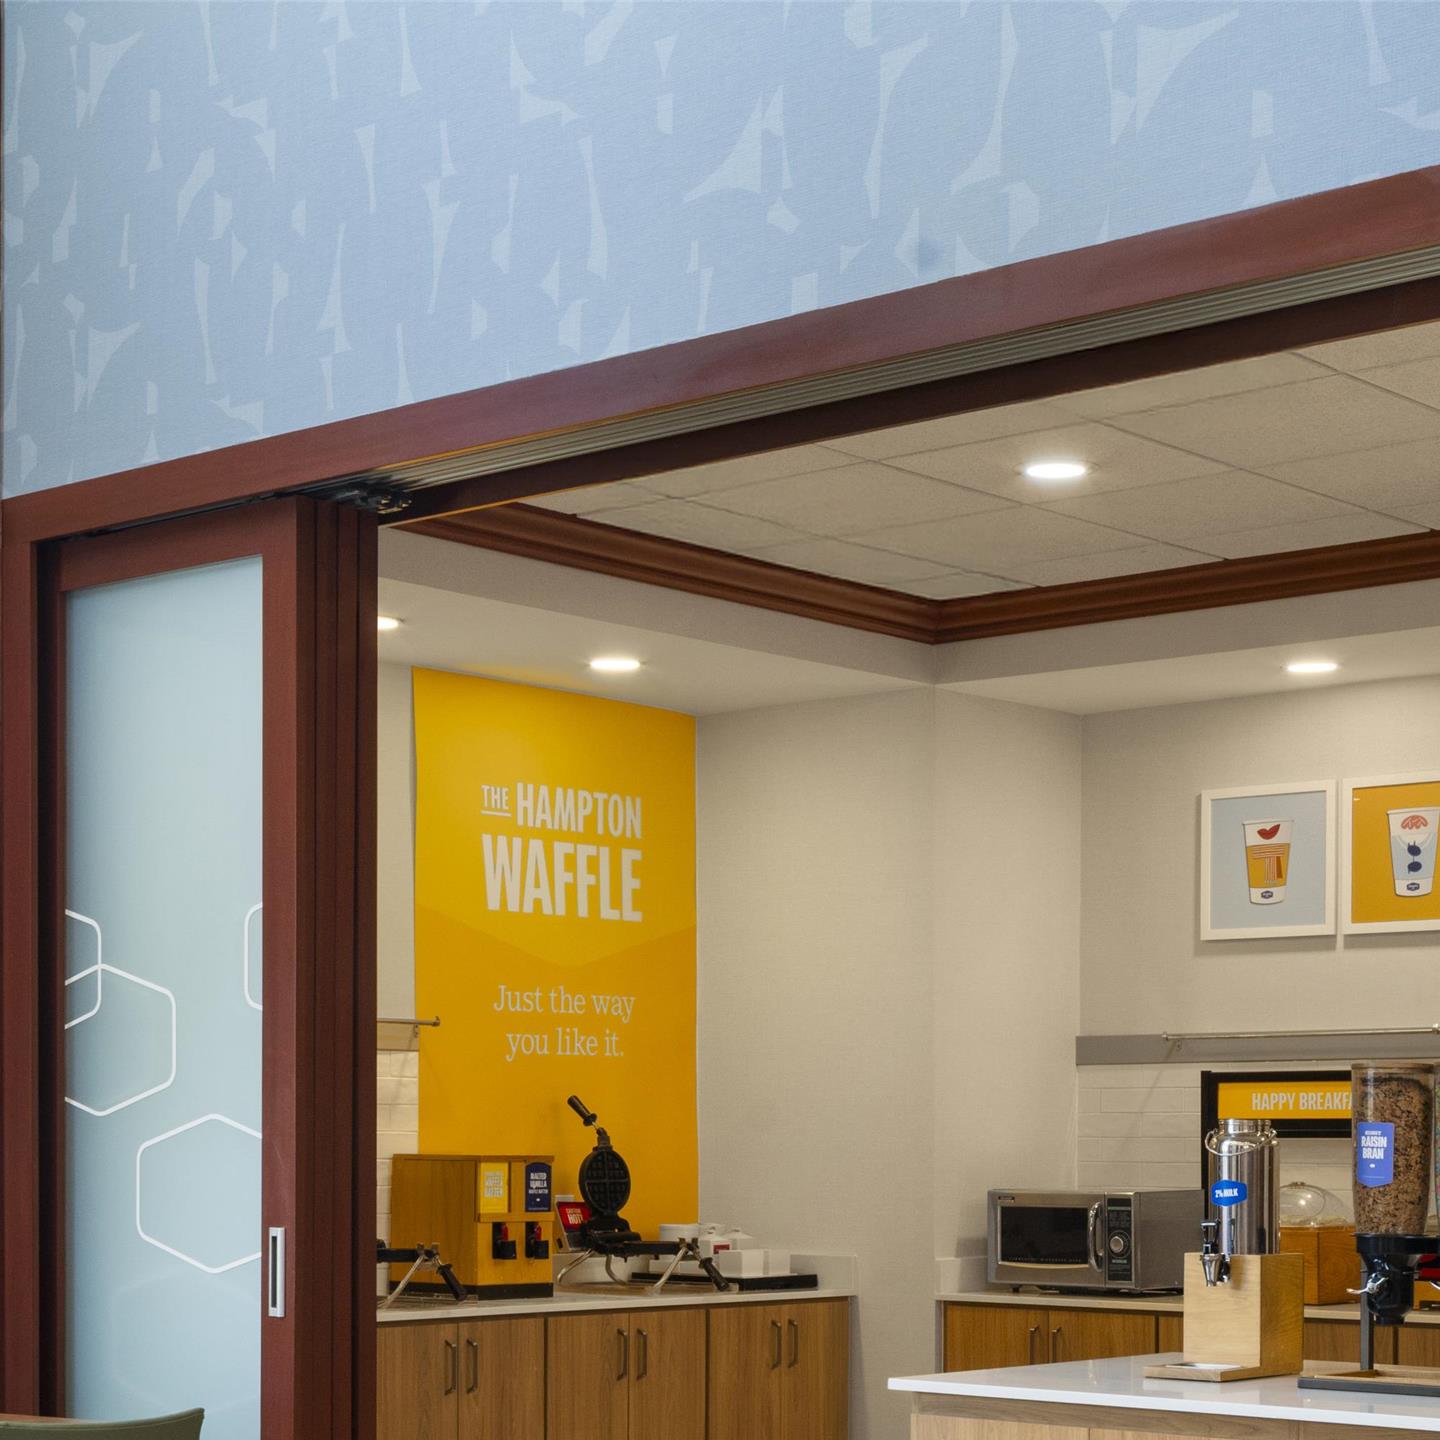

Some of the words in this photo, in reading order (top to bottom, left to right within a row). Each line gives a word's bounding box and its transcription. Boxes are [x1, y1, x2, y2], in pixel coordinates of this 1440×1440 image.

[481, 784, 509, 809] THE
[516, 782, 642, 839] HAMPTON
[481, 834, 642, 922] WAFFLE
[494, 984, 543, 1012] Just
[549, 985, 586, 1014] the
[592, 994, 635, 1024] way
[506, 1033, 549, 1062] you
[556, 1027, 598, 1056] like
[604, 1029, 624, 1056] it.
[1252, 1092, 1296, 1111] HAPPY
[1361, 1135, 1388, 1148] RAISIN
[1362, 1147, 1384, 1160] BRAN
